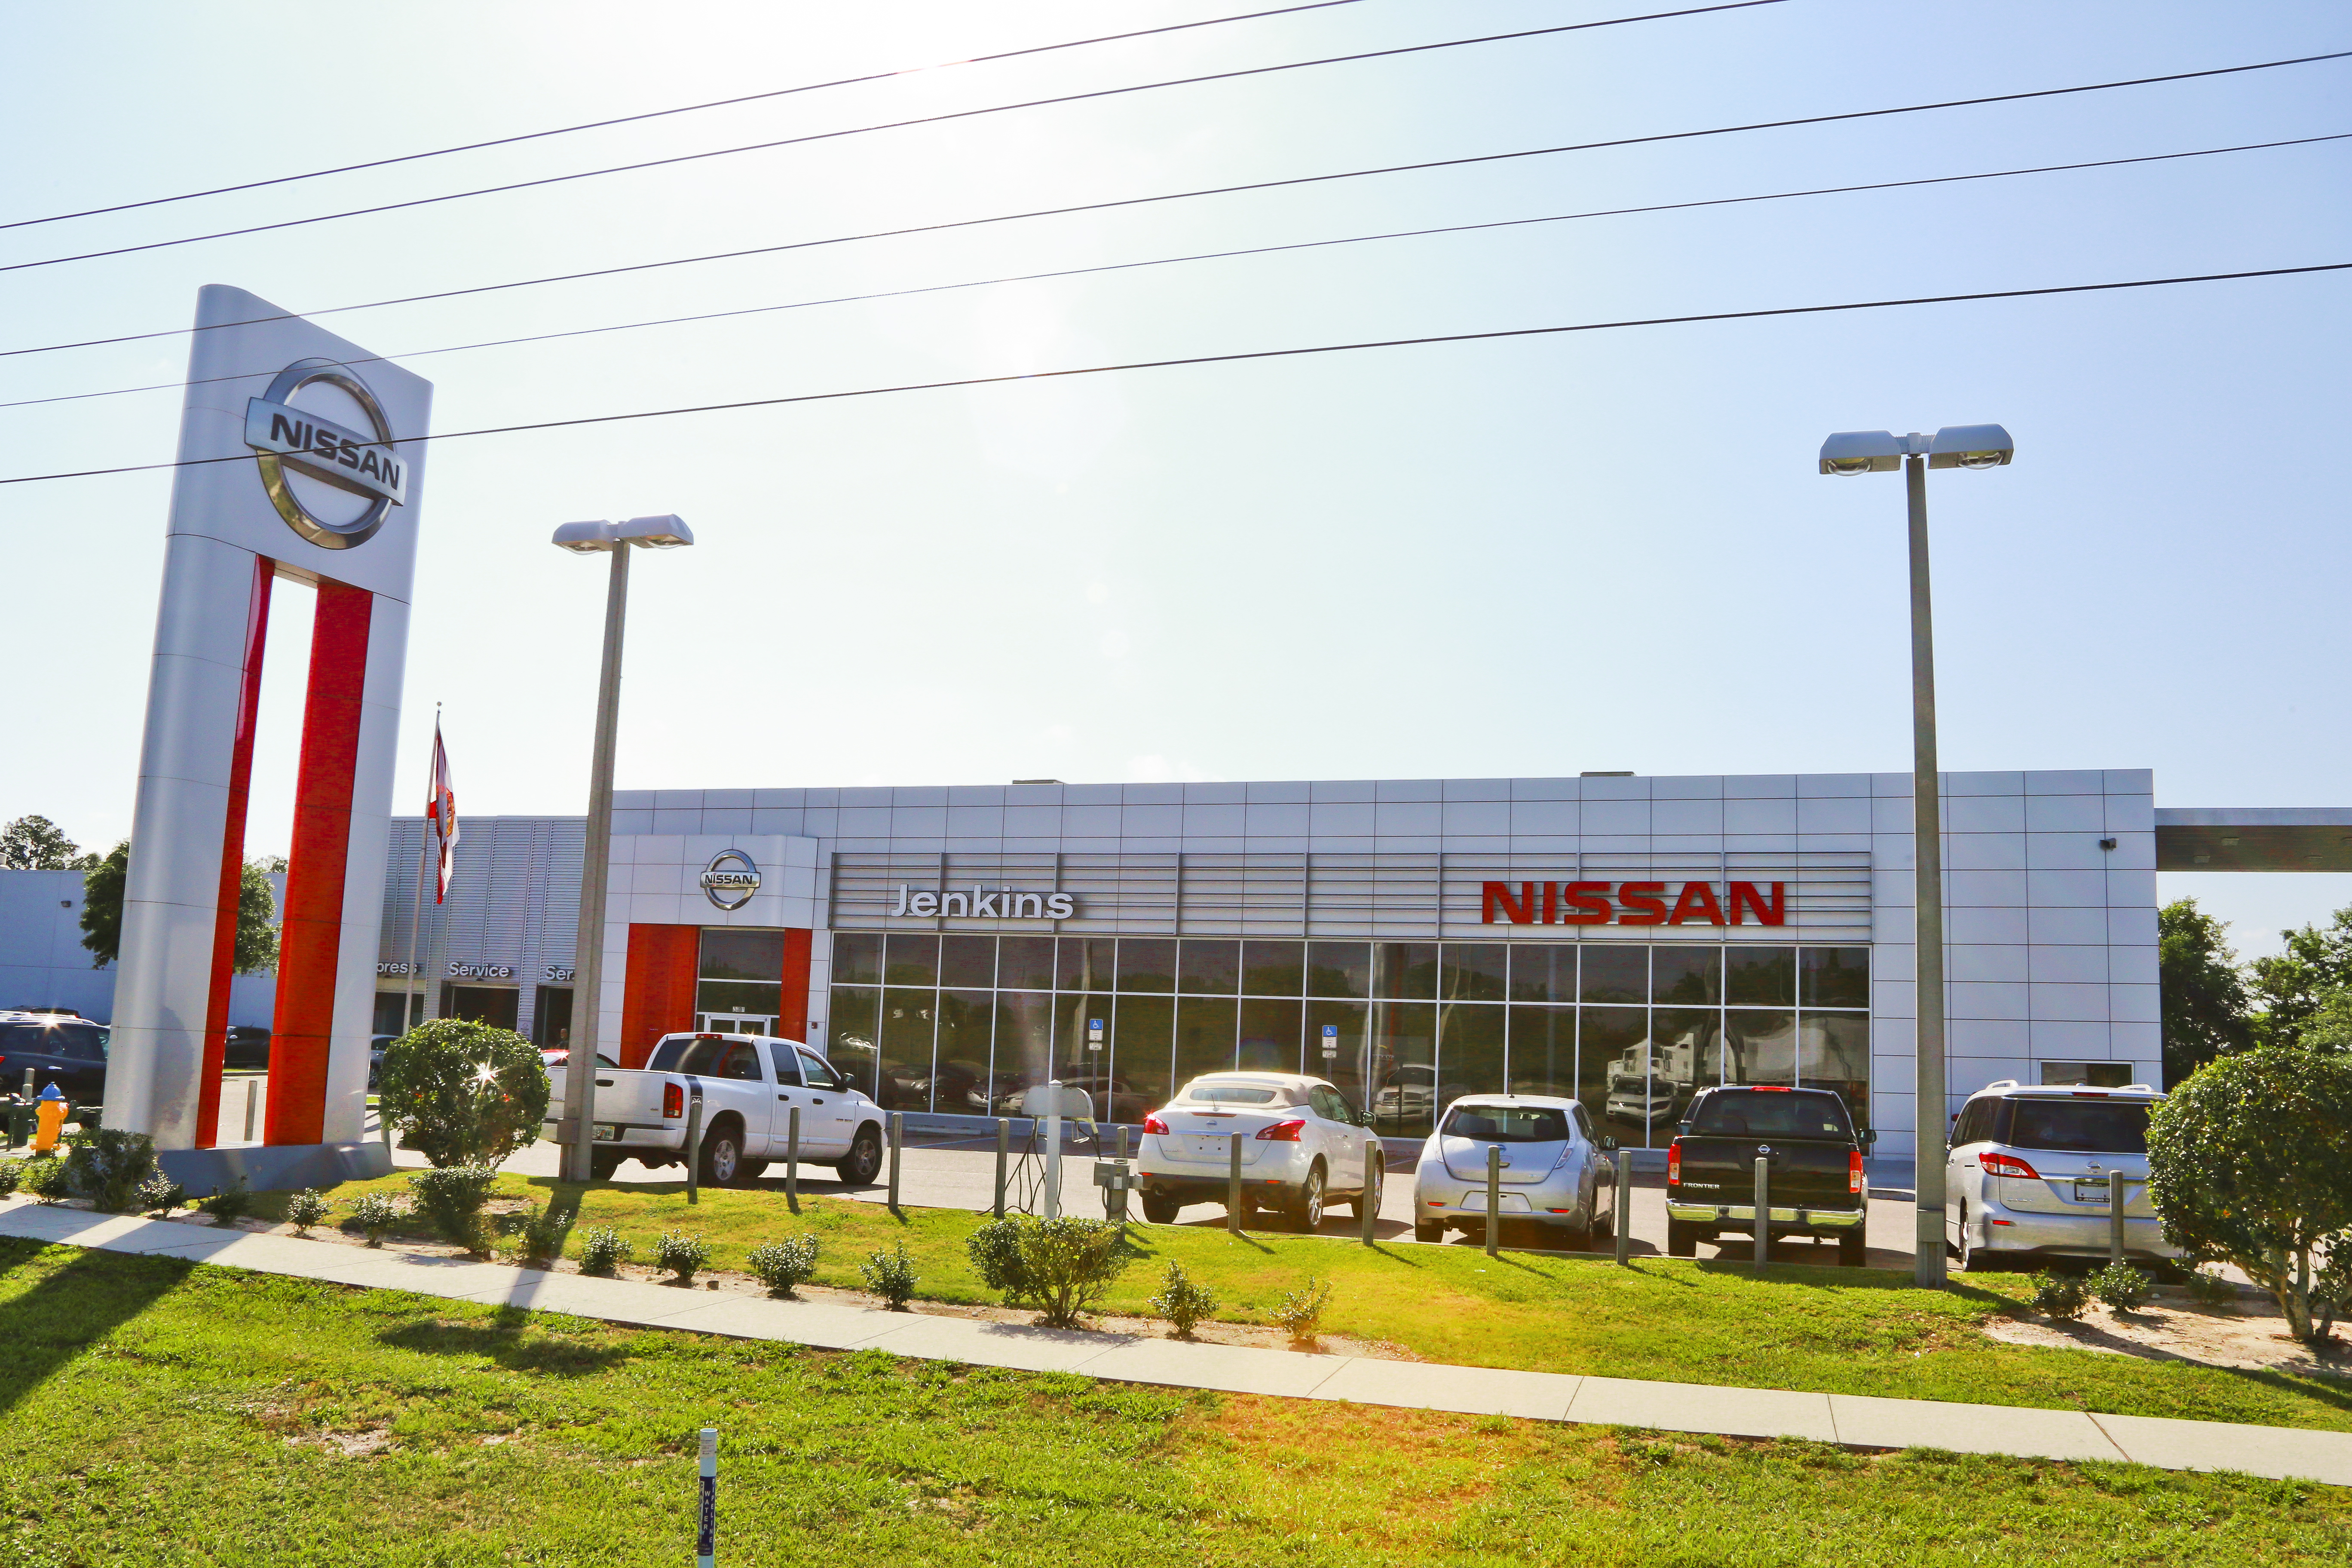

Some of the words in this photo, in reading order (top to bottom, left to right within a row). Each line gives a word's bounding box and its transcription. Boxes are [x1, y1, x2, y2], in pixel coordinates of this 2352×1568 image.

[270, 413, 399, 490] NISSAN
[705, 875, 752, 885] NISSAN
[891, 884, 1074, 919] Jenkins
[1482, 881, 1784, 925] NISSAN
[449, 962, 509, 977] Service
[545, 966, 575, 980] Ser
